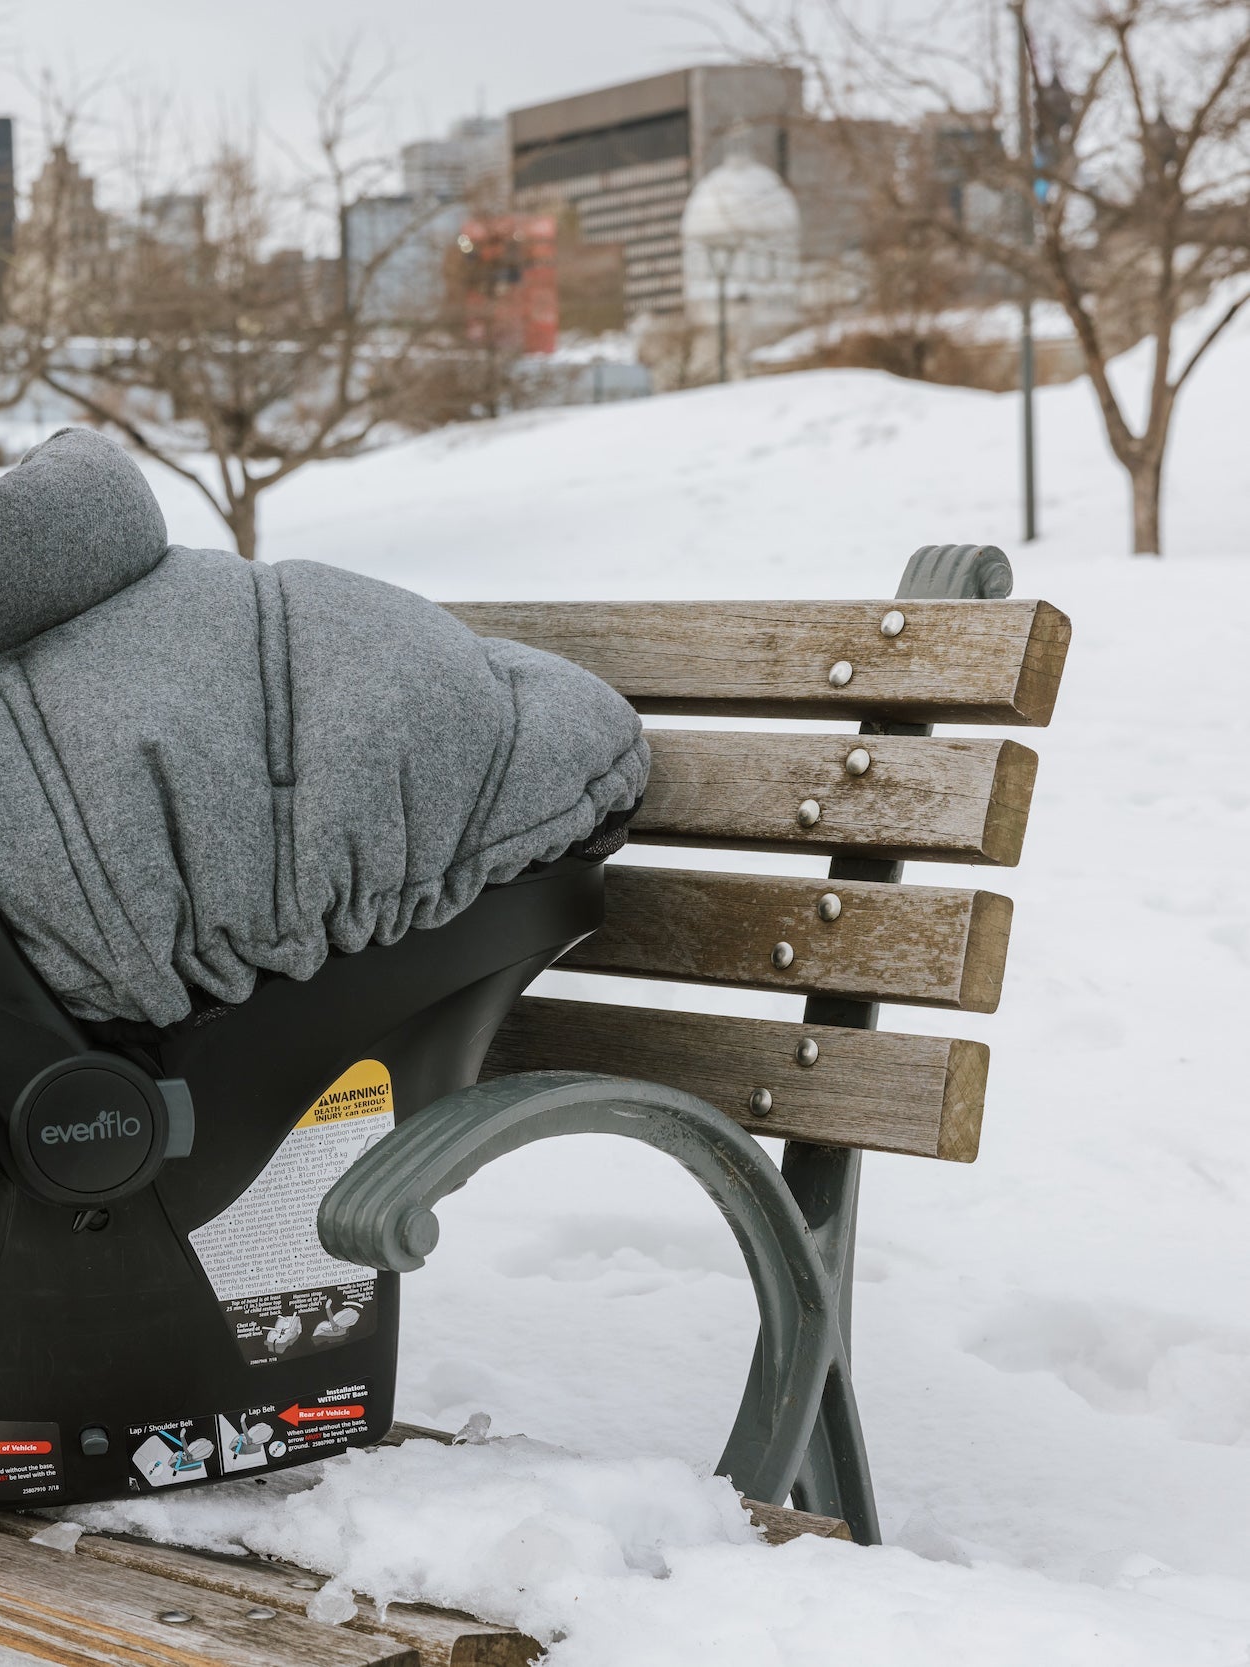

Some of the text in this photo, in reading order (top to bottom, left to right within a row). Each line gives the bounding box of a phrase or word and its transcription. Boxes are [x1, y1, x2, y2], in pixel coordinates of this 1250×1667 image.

[330, 1084, 389, 1104] WARNING!
[314, 1105, 340, 1115] DEATH
[353, 1097, 385, 1108] SERIOUS
[316, 1112, 341, 1122] INJURY
[40, 1111, 141, 1144] evenflo
[326, 1385, 365, 1395] Installation
[318, 1393, 350, 1403] WITHOUT
[148, 1423, 178, 1432] Shoulder
[318, 1423, 340, 1431] without
[288, 1442, 310, 1451] ground.
